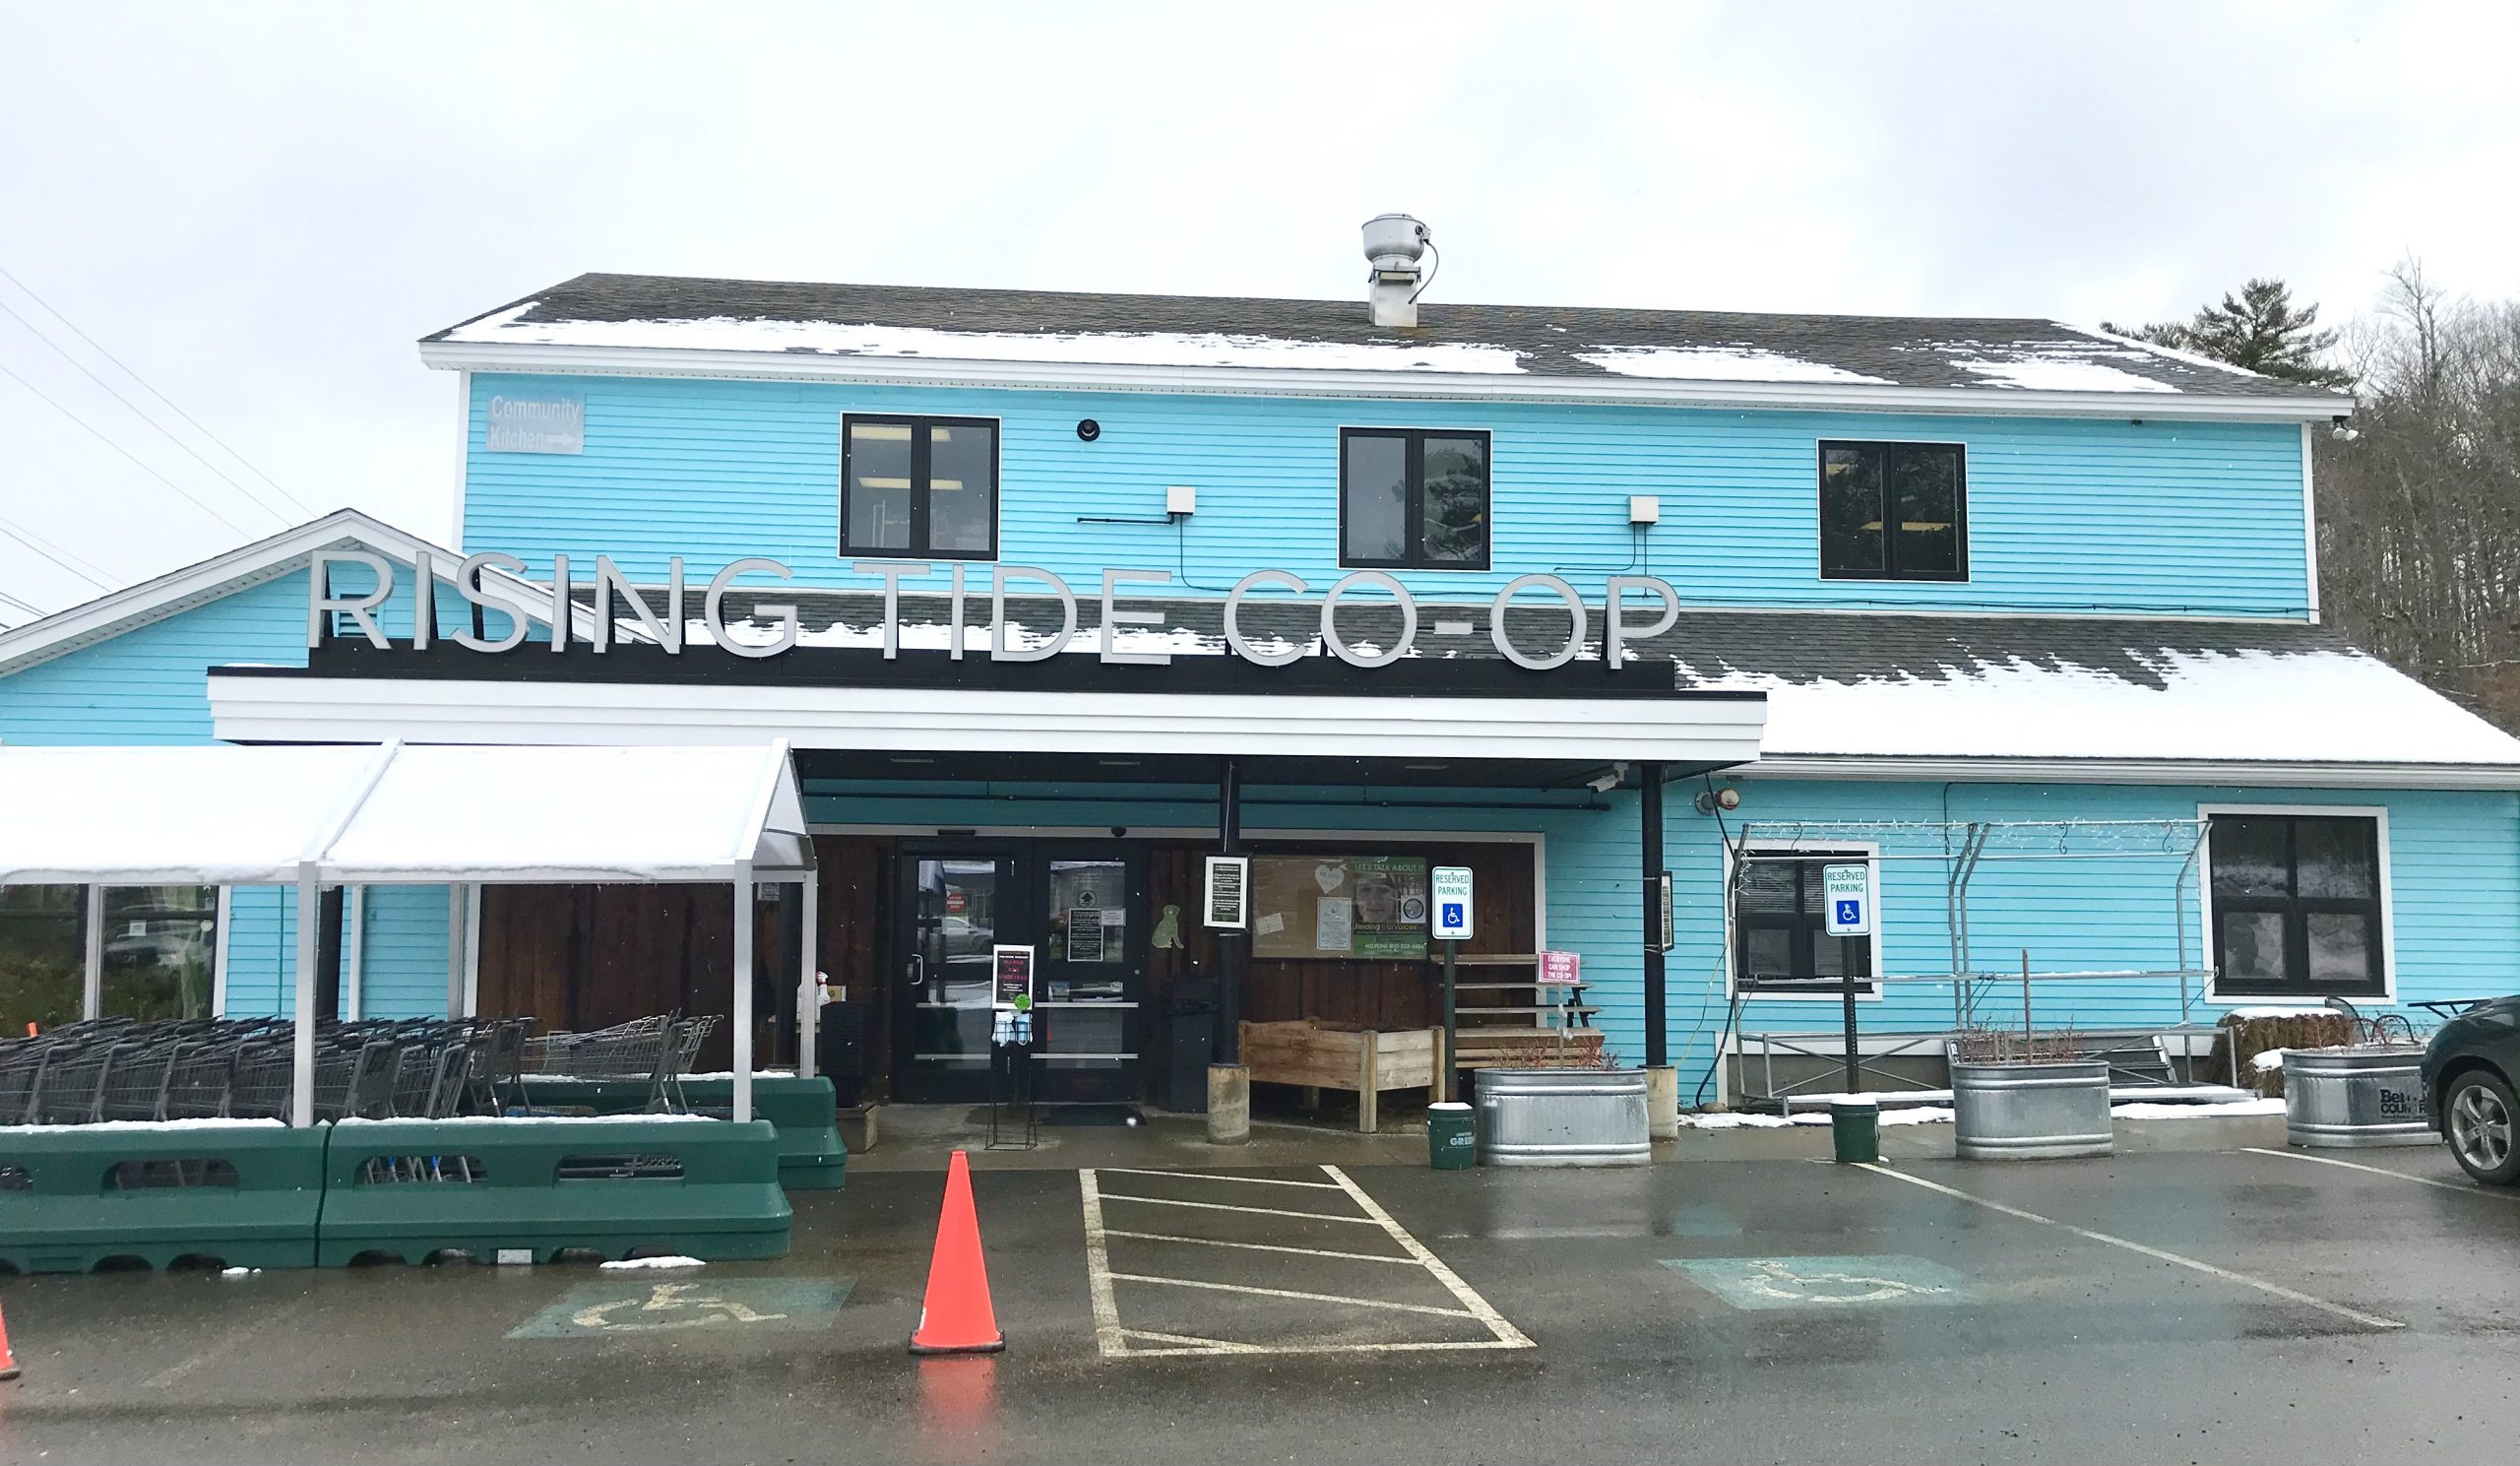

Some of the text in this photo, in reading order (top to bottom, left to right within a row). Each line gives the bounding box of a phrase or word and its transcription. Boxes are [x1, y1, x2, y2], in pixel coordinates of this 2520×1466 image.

[491, 395, 580, 425] Community
[490, 425, 543, 448] Kitchen
[306, 549, 1679, 670] RISING TIDE CO-OP
[1435, 873, 1470, 884] RESERVED
[1827, 871, 1864, 881] RESERVED
[1437, 886, 1468, 896] PARKING
[1830, 884, 1863, 892] PARKING
